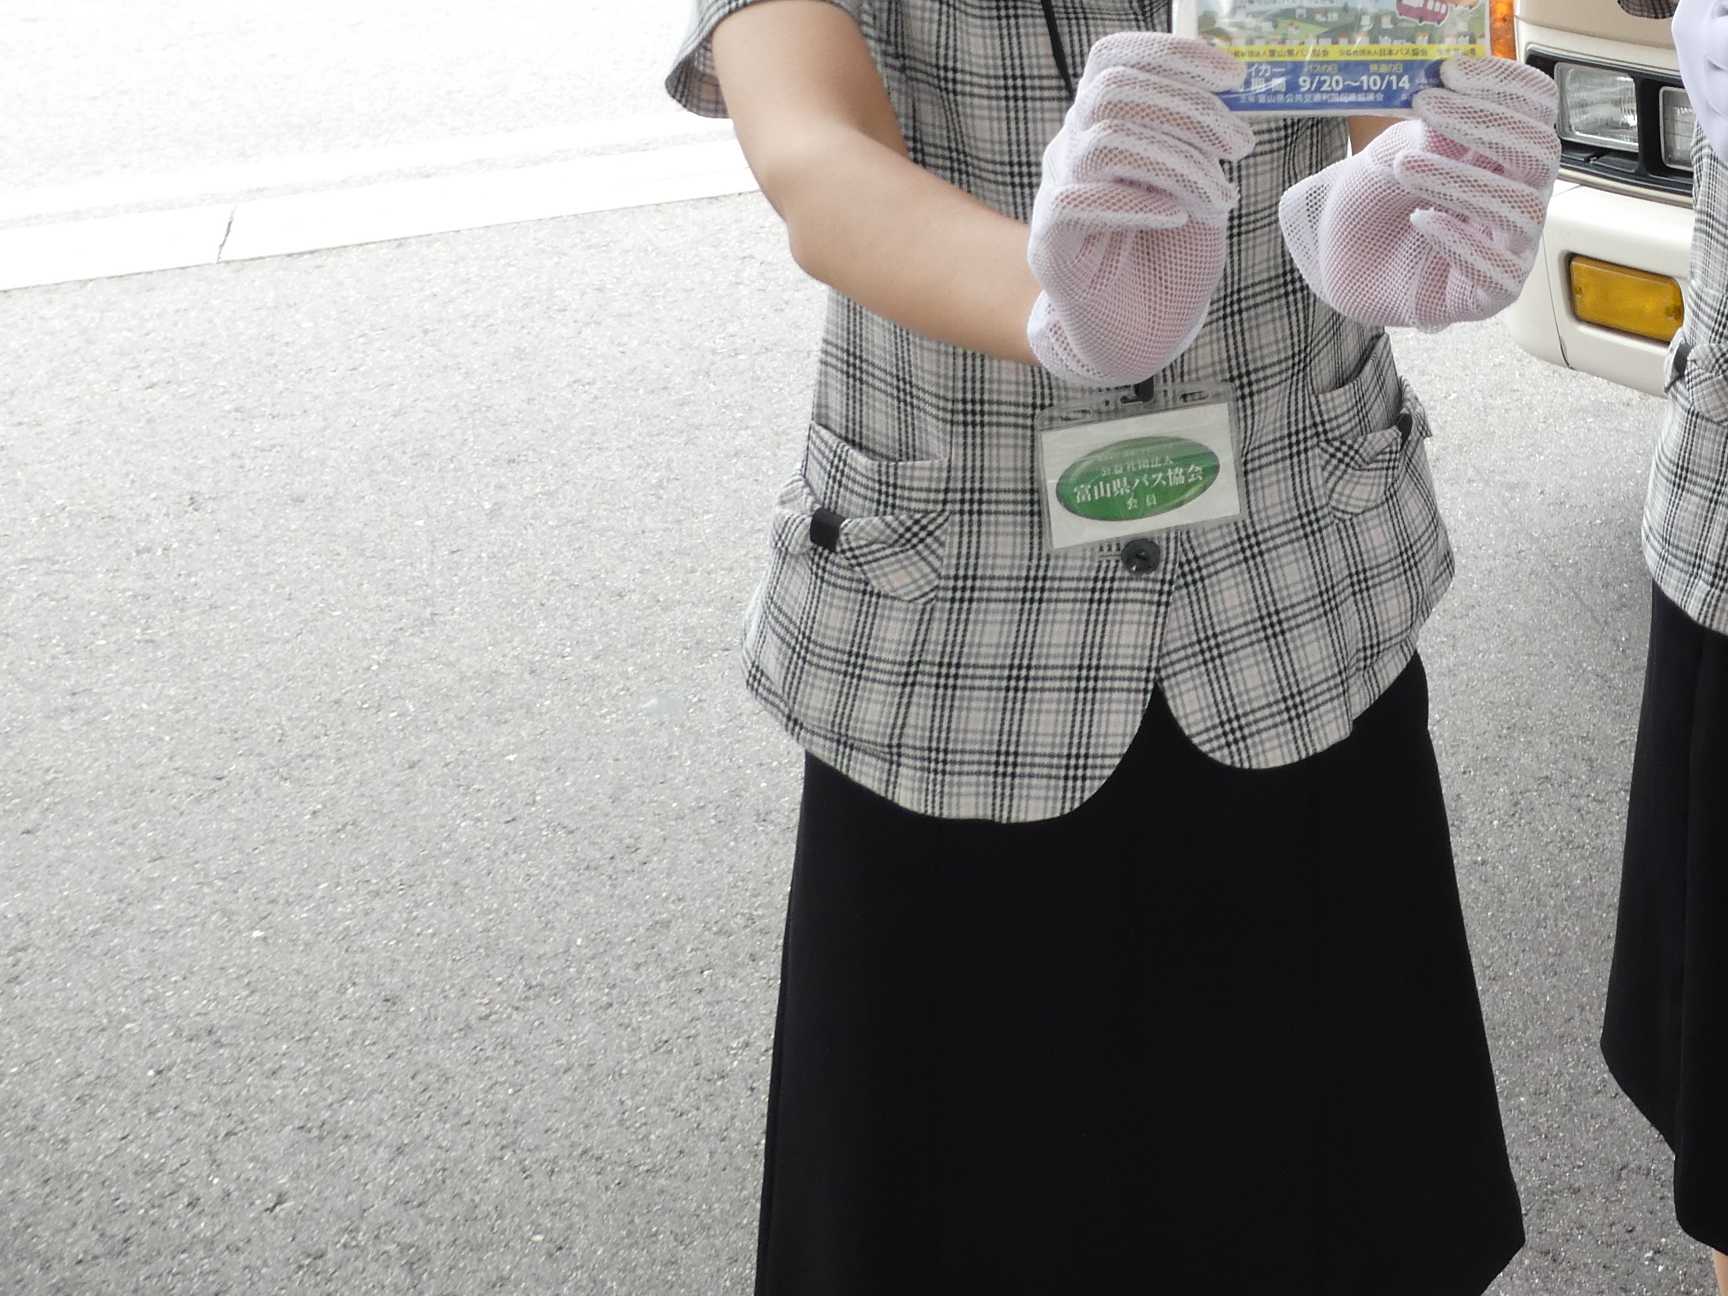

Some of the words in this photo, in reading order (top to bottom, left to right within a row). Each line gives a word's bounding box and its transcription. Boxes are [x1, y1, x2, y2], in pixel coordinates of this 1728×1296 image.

[1072, 463, 1205, 504] 富山県バス協会
[1126, 494, 1158, 511] 会員
